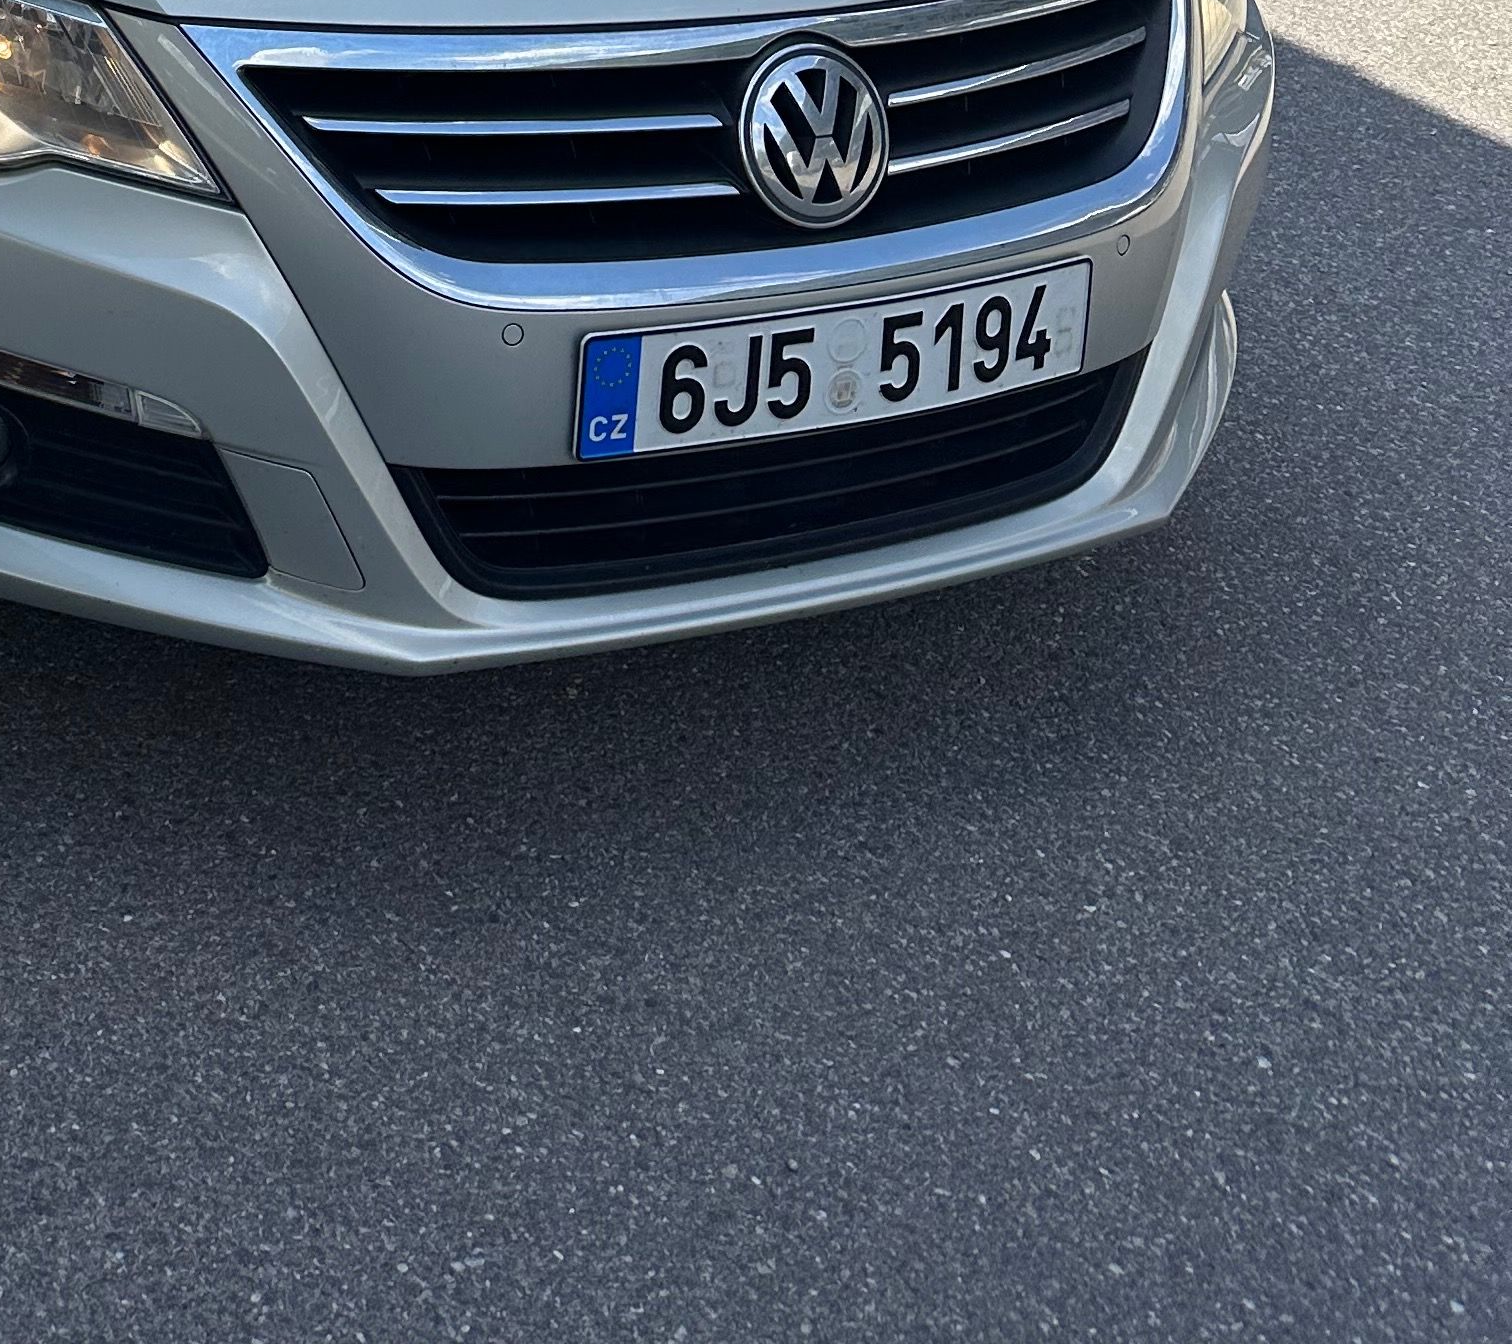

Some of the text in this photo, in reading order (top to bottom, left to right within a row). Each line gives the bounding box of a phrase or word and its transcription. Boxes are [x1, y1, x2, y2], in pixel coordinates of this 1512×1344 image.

[751, 54, 882, 216] VW
[589, 414, 628, 441] CZ
[659, 285, 1051, 434] 6J5 5194
